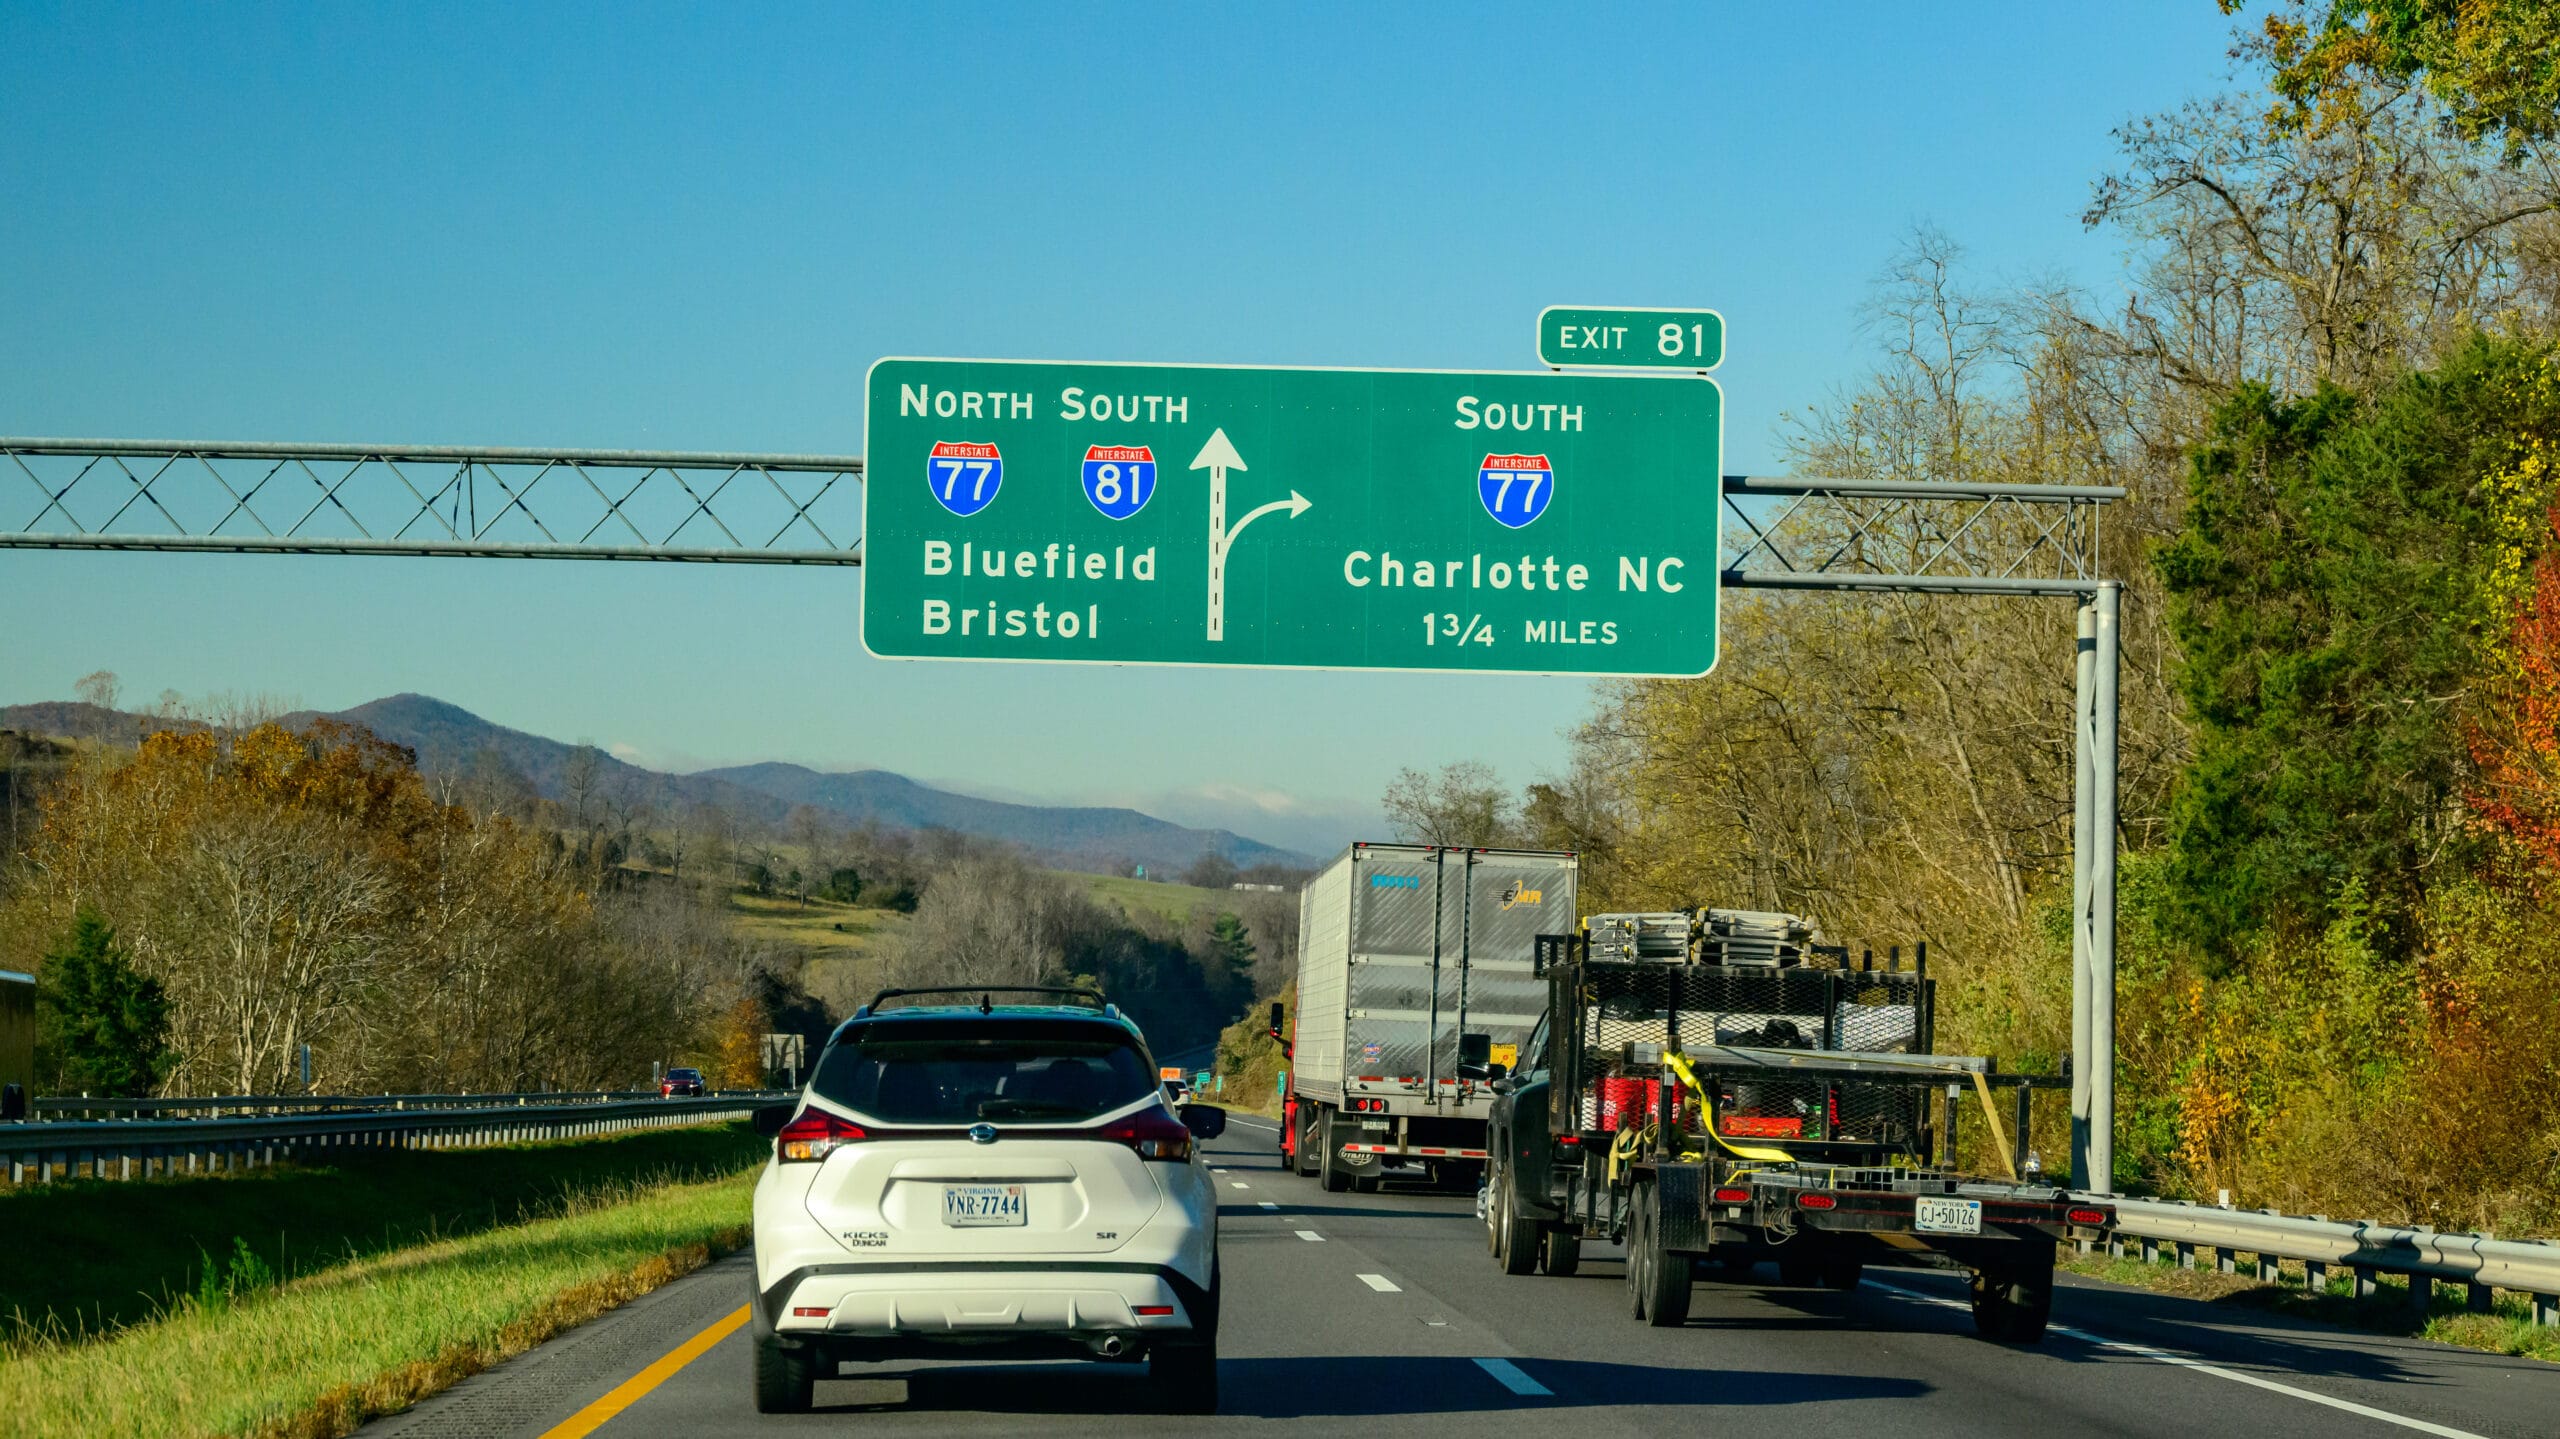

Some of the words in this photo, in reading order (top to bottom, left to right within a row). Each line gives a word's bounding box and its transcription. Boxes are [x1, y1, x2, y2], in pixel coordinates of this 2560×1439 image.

[1560, 326, 1628, 349] EXIT
[1657, 323, 1703, 357] 81
[900, 383, 1033, 419] NORTH
[1060, 387, 1188, 423] SOUTH
[1454, 395, 1583, 432] SOUTH
[940, 446, 991, 457] INTERSTATE
[1094, 450, 1144, 460] INTERSTATE
[1490, 458, 1542, 470] INTERSTATE
[936, 460, 993, 501] 77
[1095, 463, 1140, 505] 81
[1487, 472, 1543, 513] 77
[924, 540, 1155, 581] Bluefield
[1344, 550, 1589, 591] Charlotte
[1619, 556, 1685, 593] NC
[923, 599, 1097, 639] Bristol
[1525, 620, 1618, 645] MILES
[947, 1195, 1020, 1215] VNR-7744
[963, 1187, 1003, 1195] VIRGINIA
[843, 1231, 889, 1239] KICKS
[1096, 1232, 1117, 1240] SR
